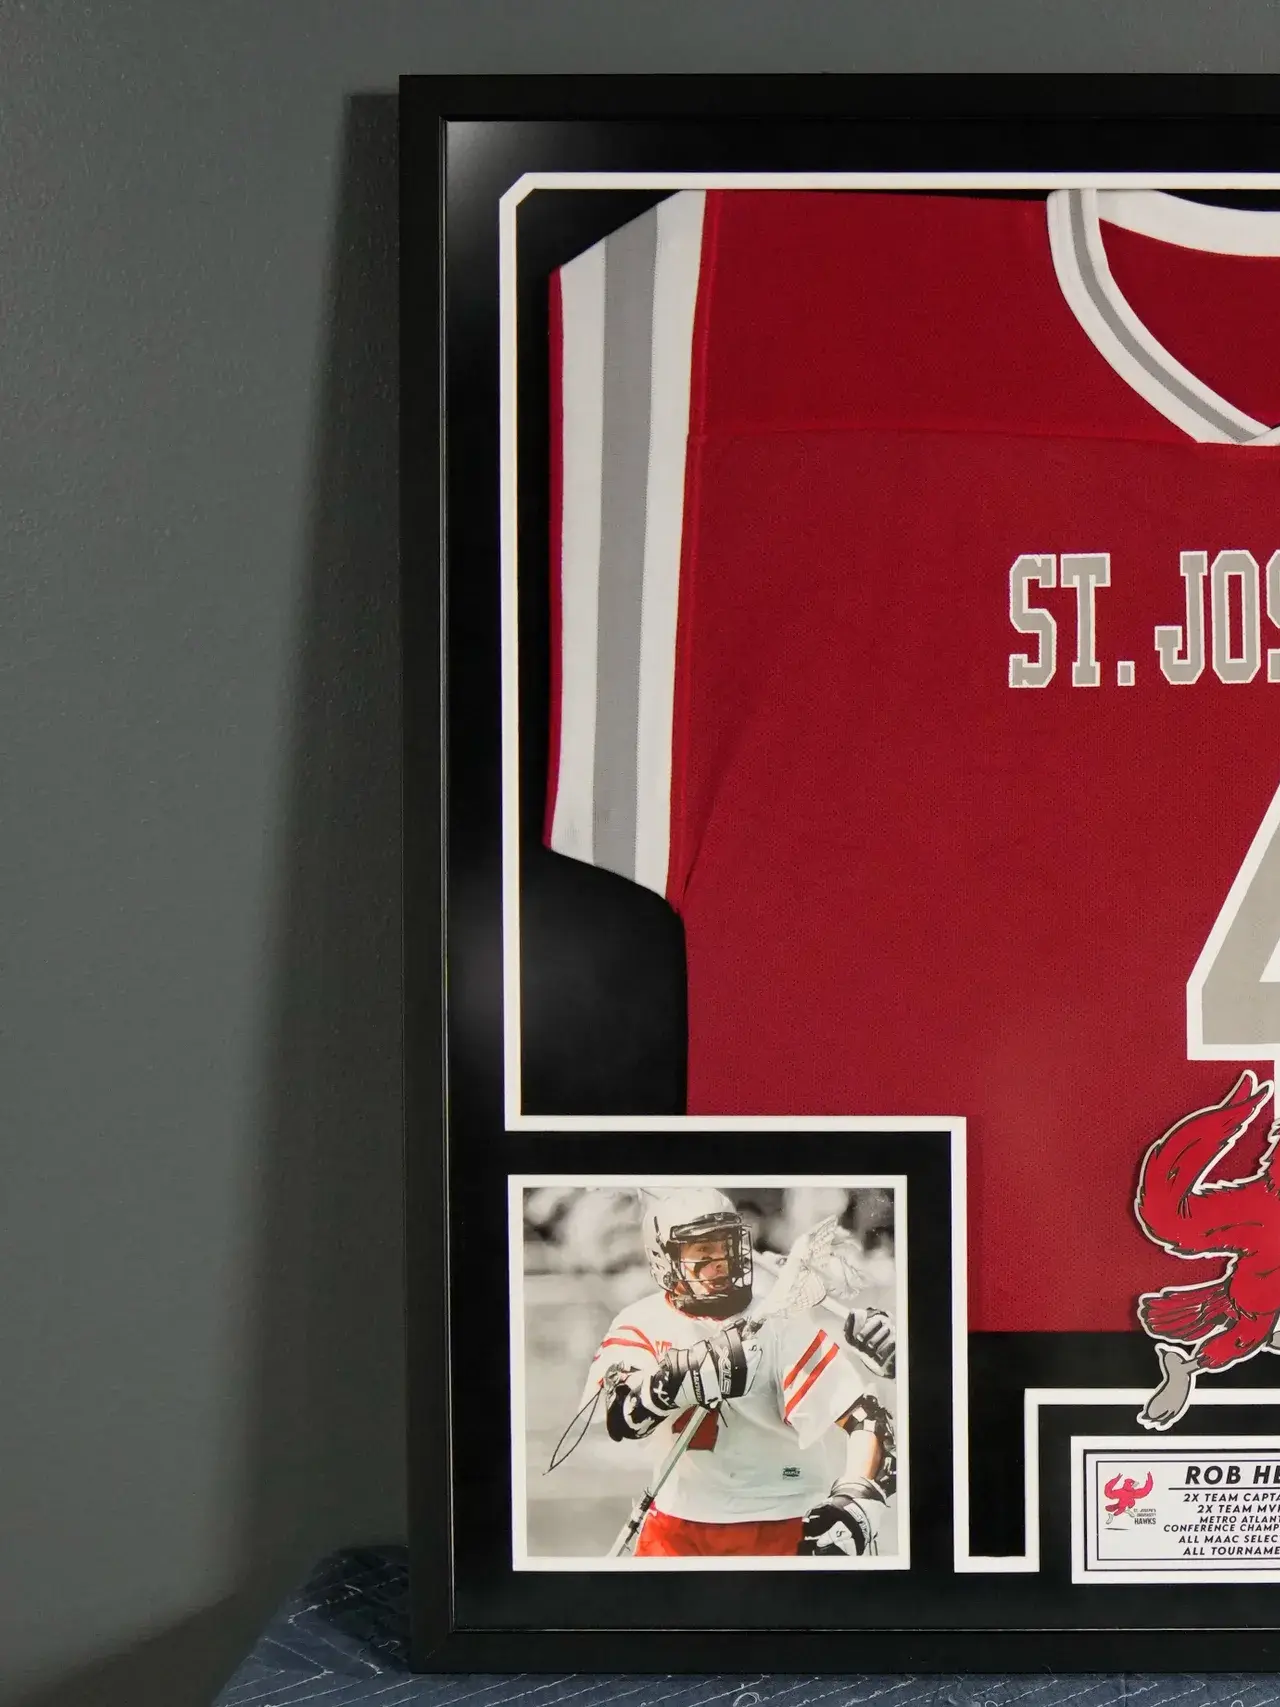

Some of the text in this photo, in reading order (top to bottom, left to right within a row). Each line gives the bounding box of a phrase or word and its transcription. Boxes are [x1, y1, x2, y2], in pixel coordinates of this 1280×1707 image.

[1008, 553, 1135, 688] ST.
[1185, 1465, 1241, 1485] ROB
[1183, 1494, 1199, 1502] 2X
[1205, 1494, 1238, 1502] TEAM
[1197, 1505, 1213, 1513] 2X
[1219, 1505, 1252, 1513] TEAM
[1200, 1516, 1237, 1524] METRO
[1164, 1524, 1235, 1532] CONFERENCE
[1204, 1535, 1239, 1543] MAAC
[1183, 1547, 1205, 1555] ALL
